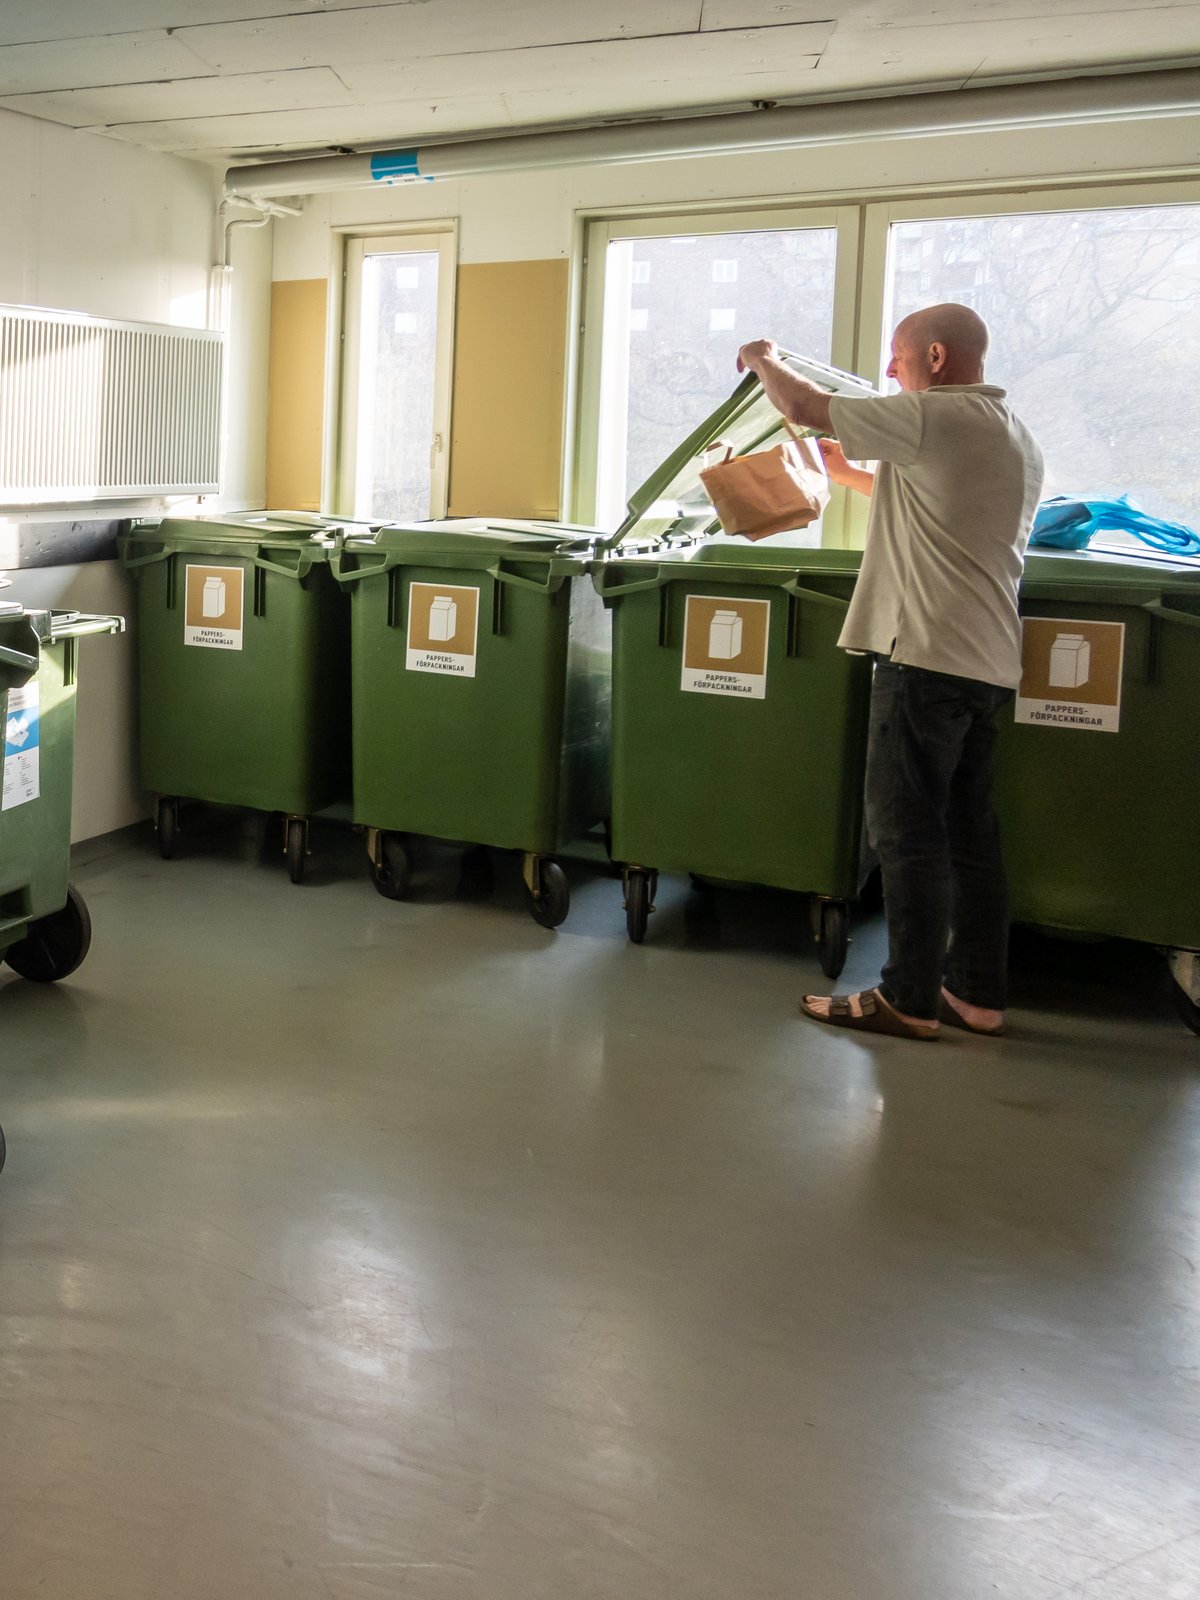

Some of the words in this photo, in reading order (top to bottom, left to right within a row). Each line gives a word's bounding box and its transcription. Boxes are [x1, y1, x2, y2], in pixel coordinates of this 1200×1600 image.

[192, 636, 233, 645] FÖRPACKNINGAR
[426, 654, 455, 663] PAPPERS-
[416, 660, 465, 671] FÖRPACKNINGAR
[705, 674, 740, 683] PAPPERS-
[693, 680, 752, 693] FÖRPACKNINGAR
[1045, 704, 1088, 714] PAPPERS-
[1030, 711, 1103, 726] FÖRPACKNINGAR
